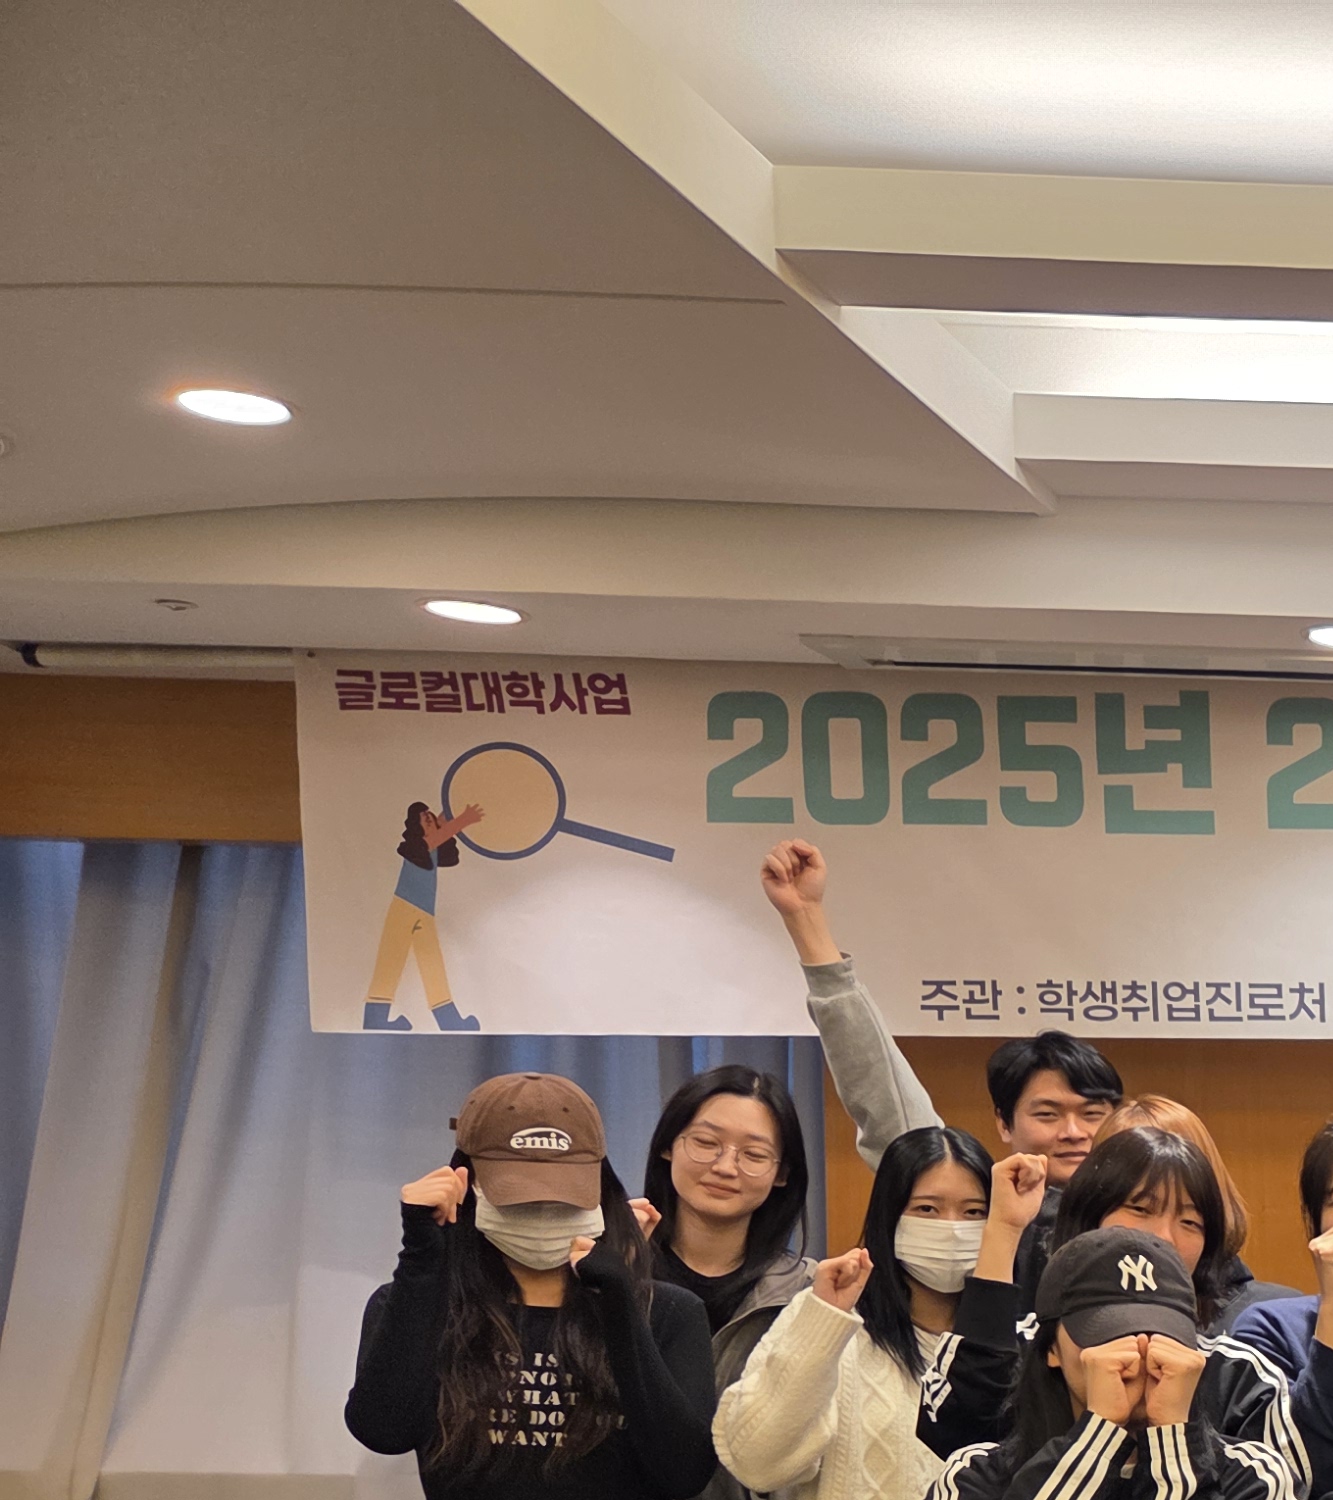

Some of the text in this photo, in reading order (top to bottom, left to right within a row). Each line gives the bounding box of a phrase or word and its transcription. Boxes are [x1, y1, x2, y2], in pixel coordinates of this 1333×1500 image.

[335, 669, 630, 715] 글로컬대학사업
[706, 690, 1215, 835] 2025년
[1036, 980, 1325, 1022] 학생취업진로처
[510, 1132, 569, 1151] emis
[1117, 1254, 1158, 1292] NY
[488, 1429, 567, 1447] WANT
